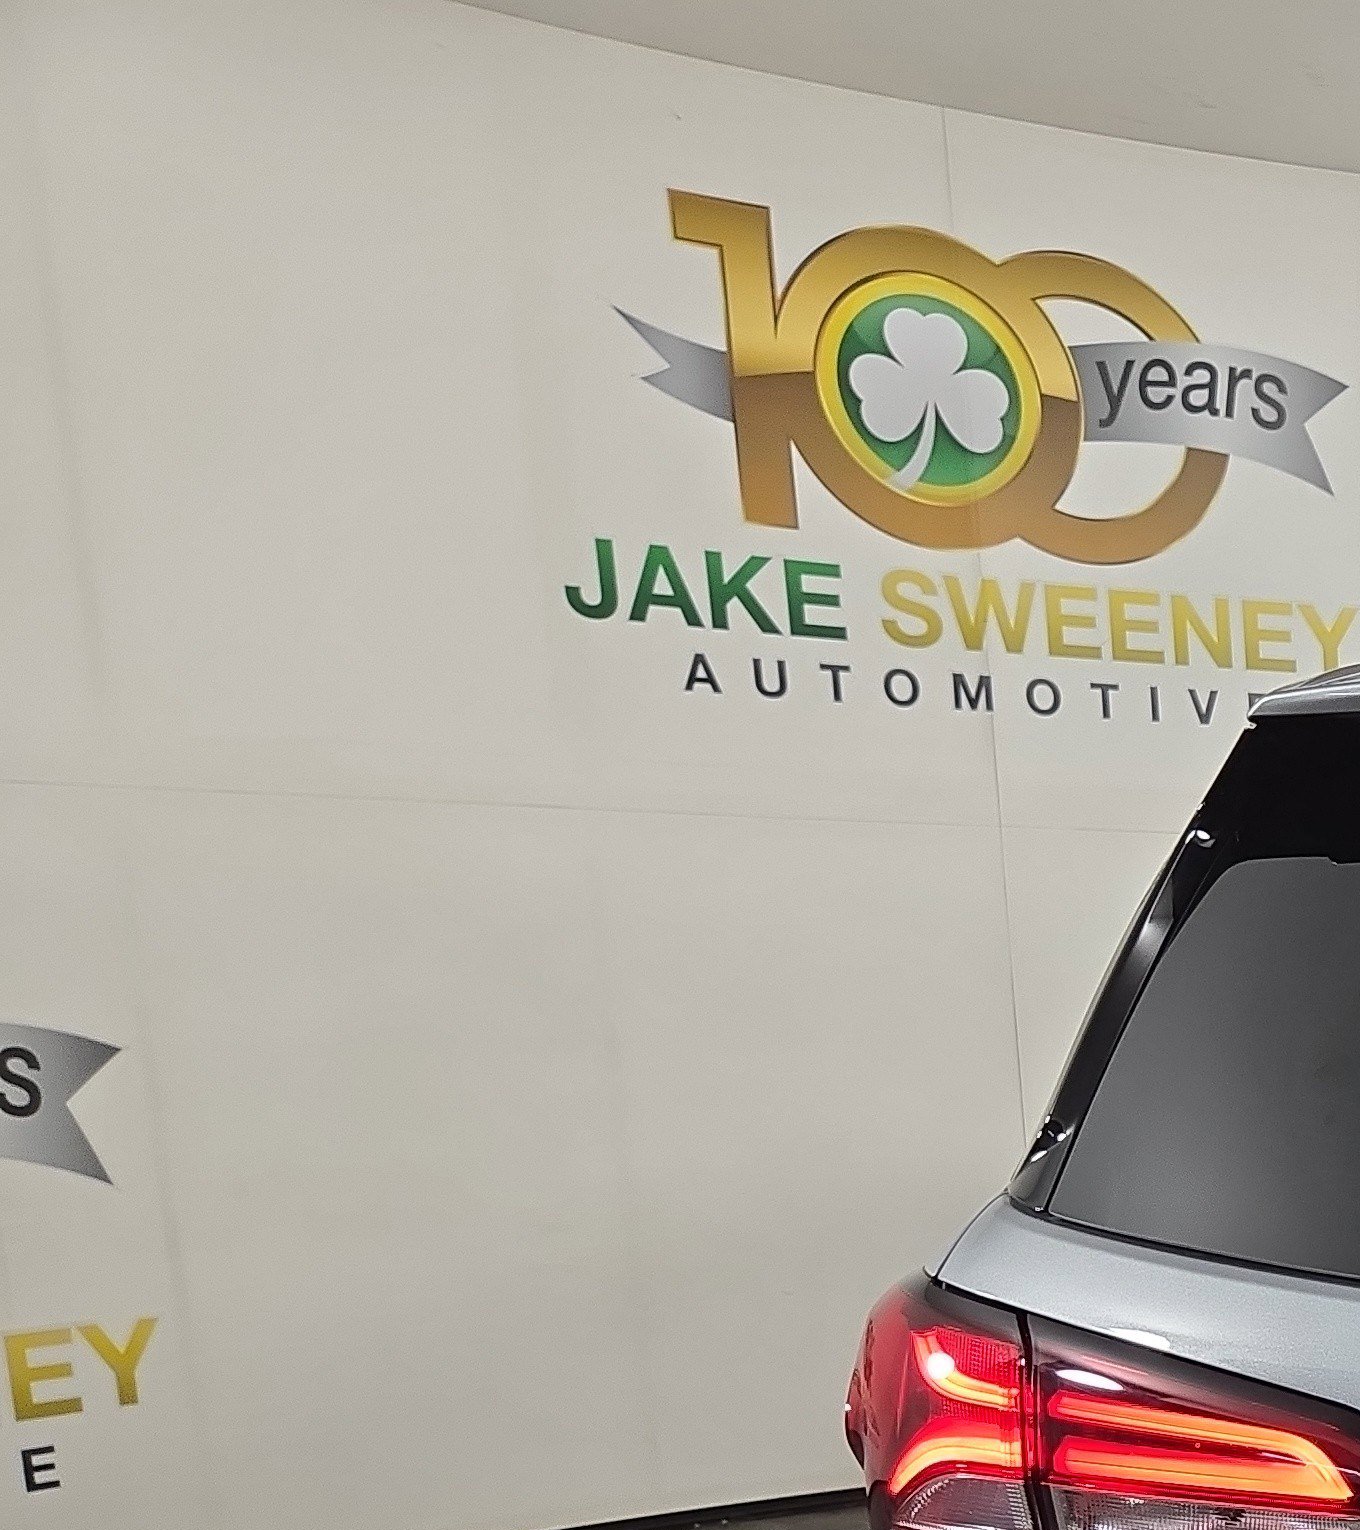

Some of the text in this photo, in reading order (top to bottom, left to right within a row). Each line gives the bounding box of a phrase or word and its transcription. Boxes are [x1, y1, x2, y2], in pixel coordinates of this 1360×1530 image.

[1096, 352, 1290, 431] years
[564, 537, 1360, 674] JAKE SWEENEY
